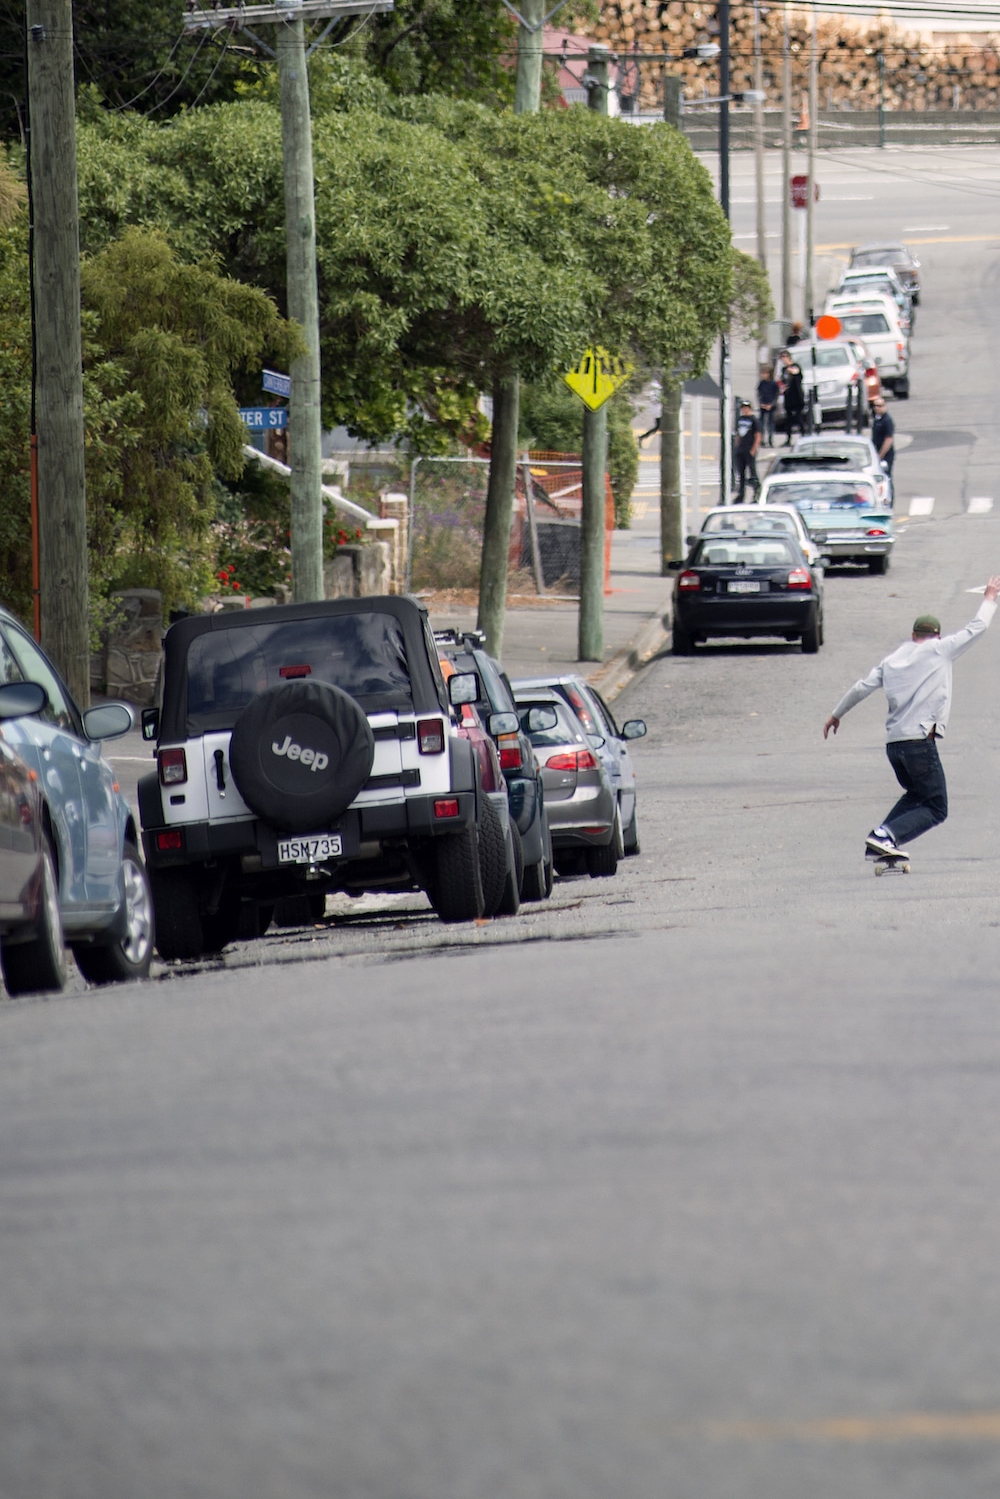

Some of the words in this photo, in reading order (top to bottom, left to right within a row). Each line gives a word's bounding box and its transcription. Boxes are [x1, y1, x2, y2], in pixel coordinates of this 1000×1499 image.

[268, 410, 284, 425] ST
[271, 735, 329, 772] Jeep
[280, 839, 340, 860] HSM735
